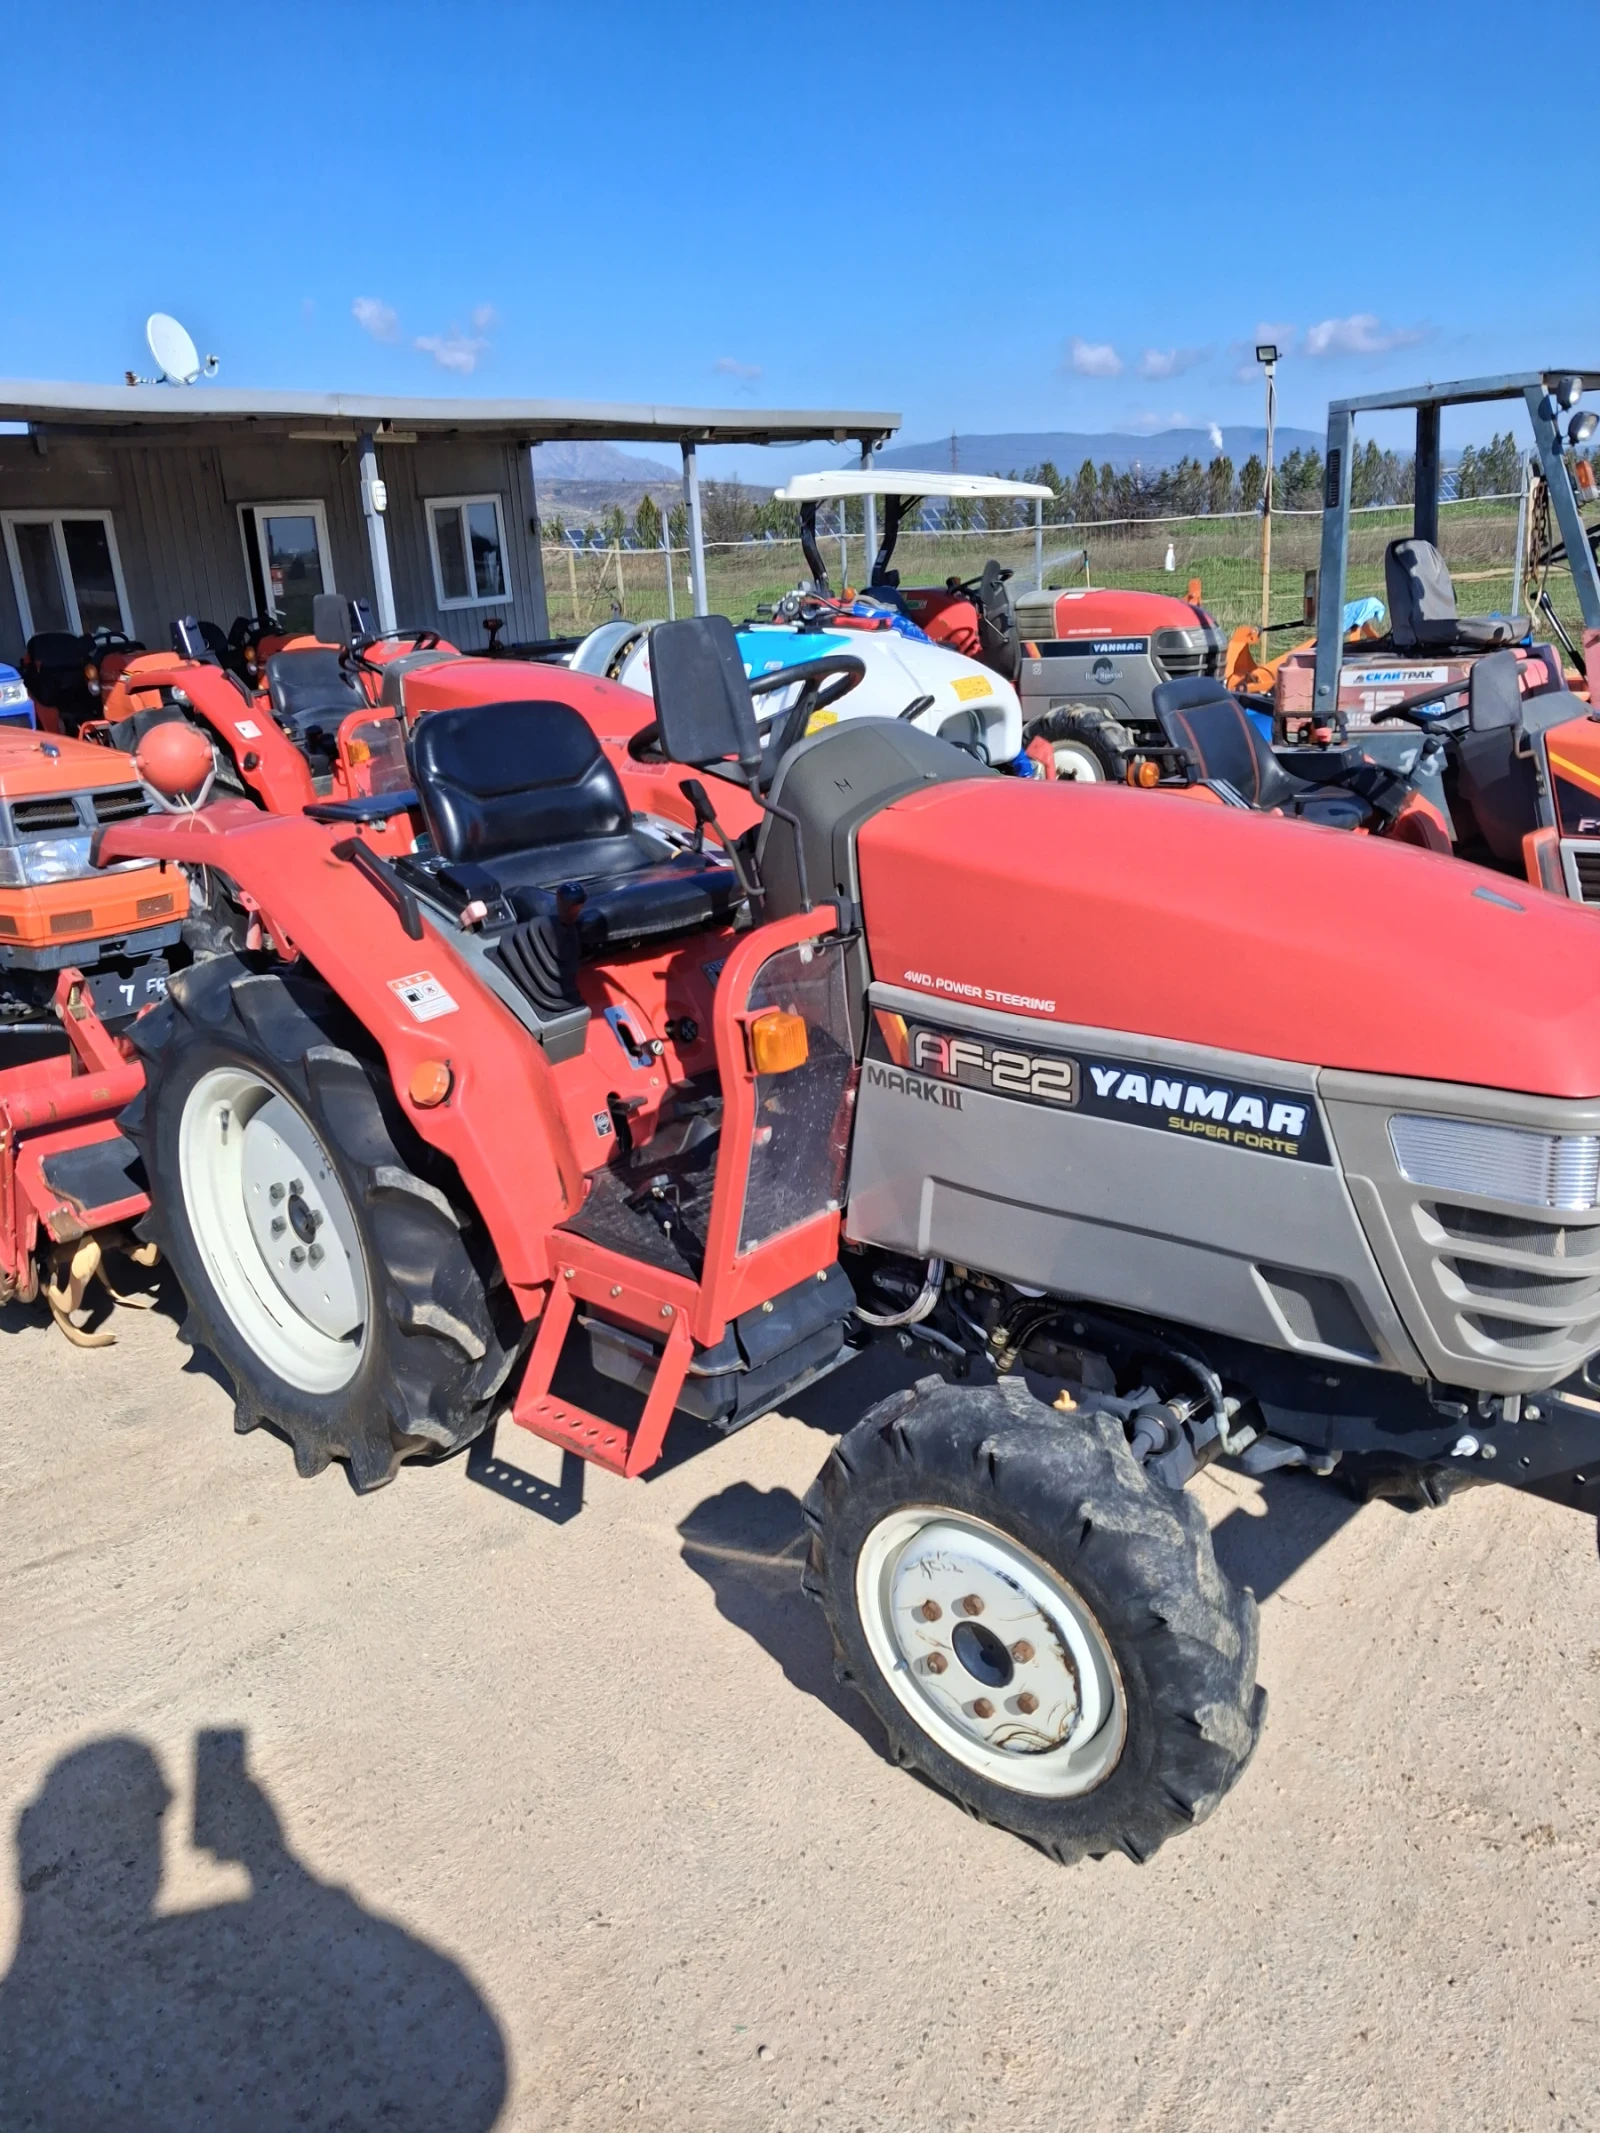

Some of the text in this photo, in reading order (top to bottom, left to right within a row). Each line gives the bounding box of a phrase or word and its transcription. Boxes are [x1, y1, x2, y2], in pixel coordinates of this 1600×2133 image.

[1093, 643, 1143, 653] YANMAR
[984, 989, 1055, 1012] STEERING
[1090, 1067, 1306, 1136] YANMAR
[1168, 1116, 1299, 1155] SUPER FORTE
